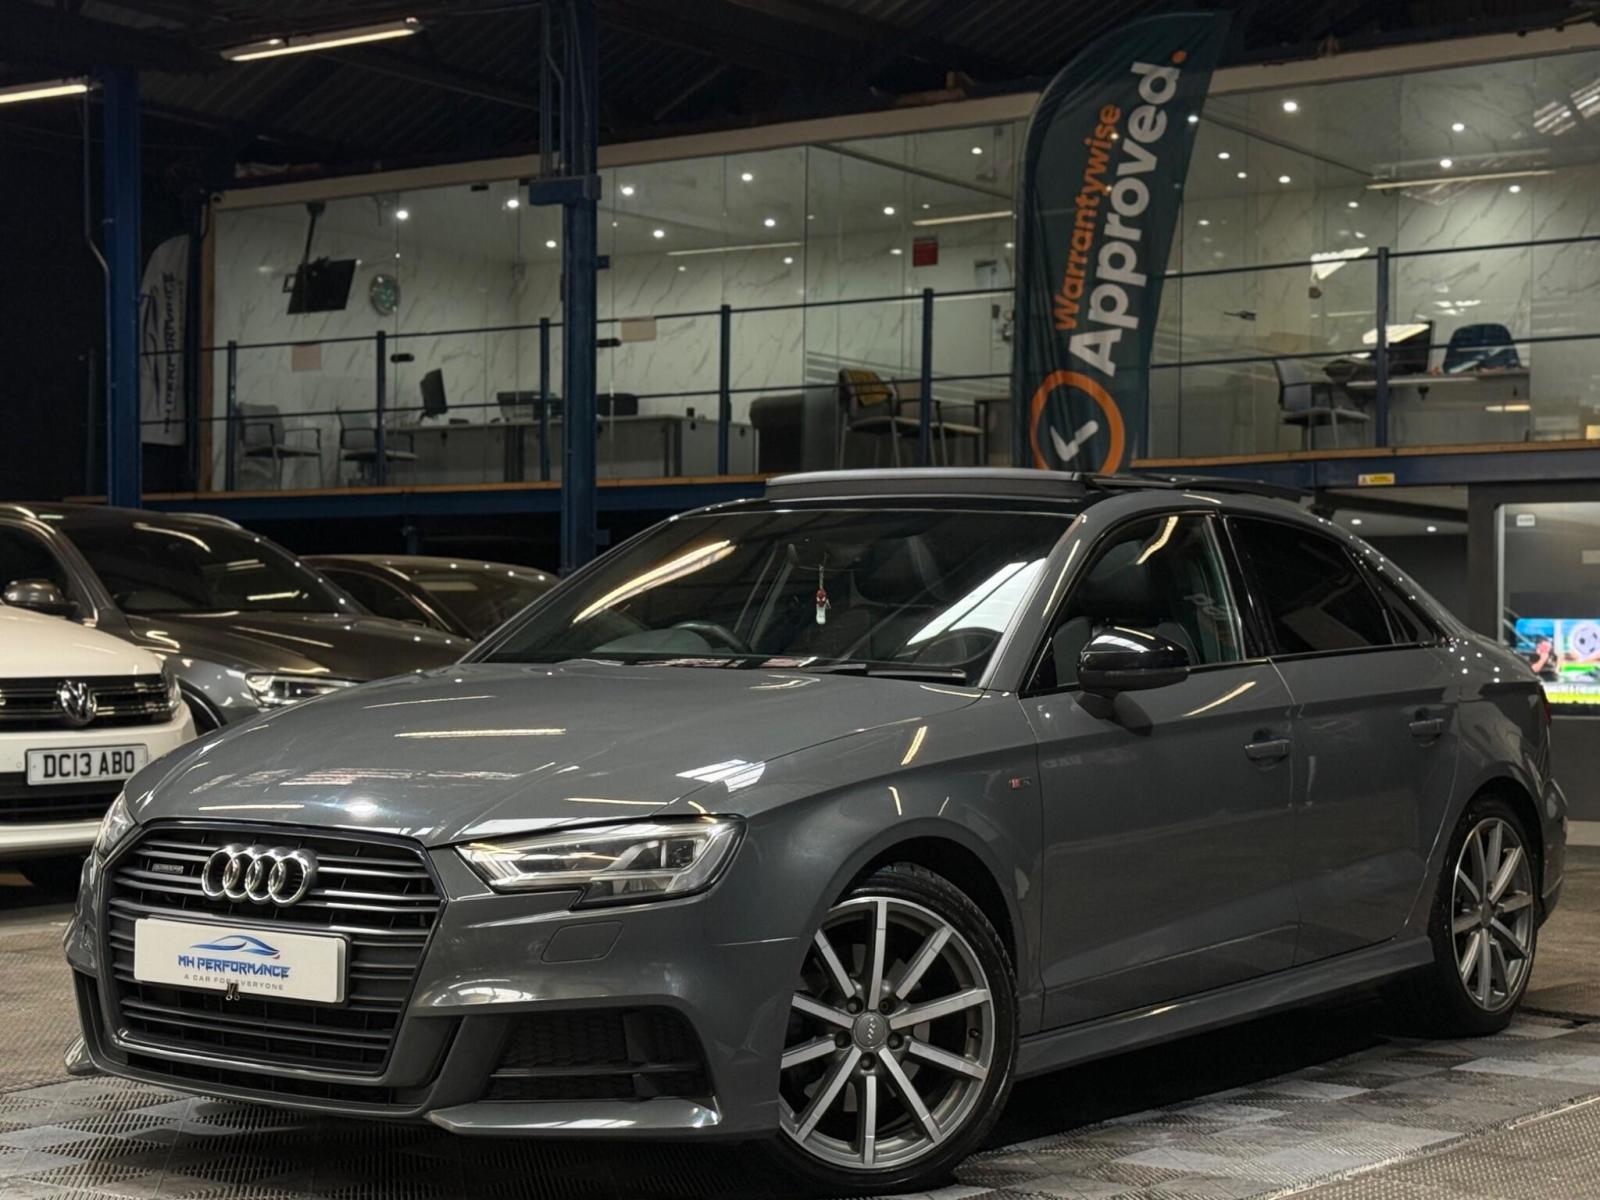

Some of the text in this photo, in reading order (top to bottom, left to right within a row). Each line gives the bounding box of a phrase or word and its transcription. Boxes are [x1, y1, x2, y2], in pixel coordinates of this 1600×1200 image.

[1053, 103, 1121, 331] Warrantywise
[43, 750, 134, 779] DC13 ABO
[178, 955, 291, 978] MH PERFORMANCE
[193, 974, 211, 982] CAR
